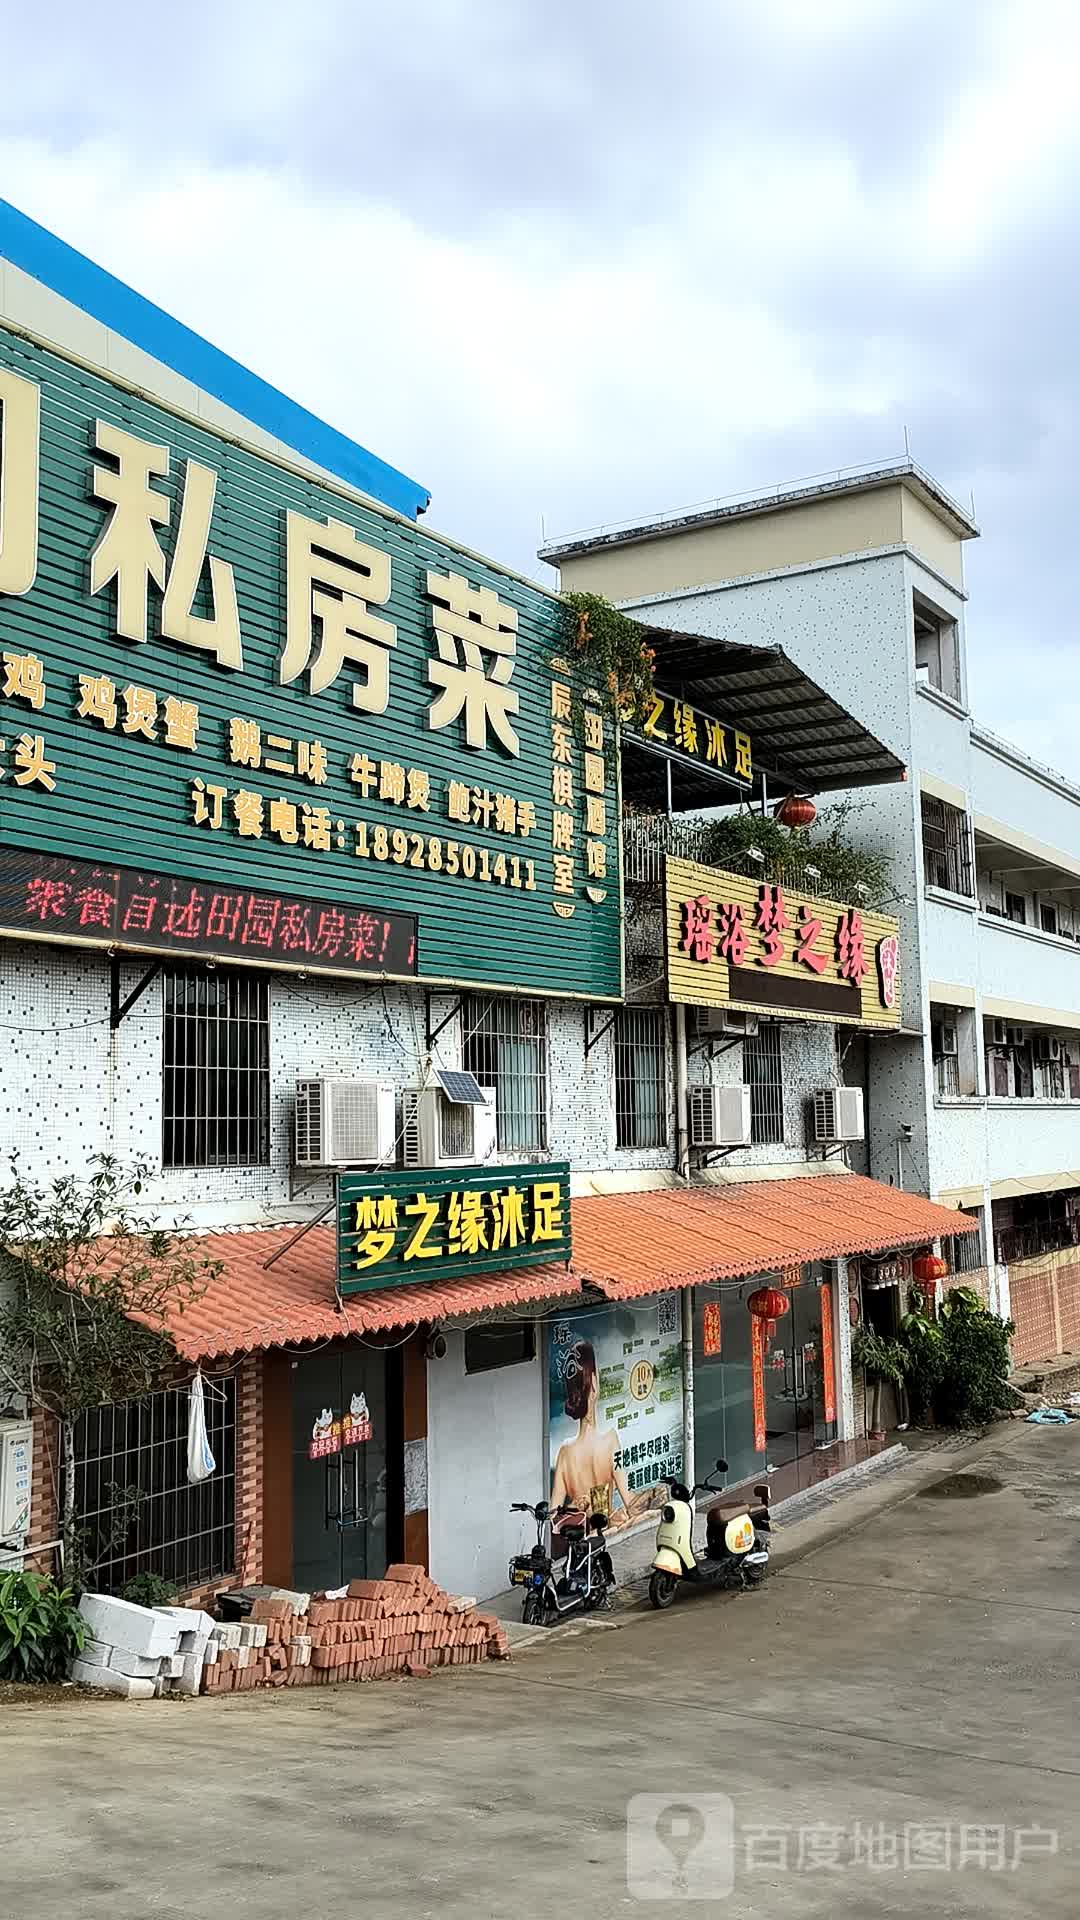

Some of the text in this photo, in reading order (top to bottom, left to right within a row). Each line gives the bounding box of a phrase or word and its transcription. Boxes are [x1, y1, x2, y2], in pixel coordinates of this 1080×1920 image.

[0, 368, 519, 757] 私房菜
[0, 733, 56, 792] 头
[77, 674, 200, 751] 鸡煲蟹
[229, 717, 328, 785] 鹅二味
[351, 753, 431, 812] 牛蹄煲
[448, 779, 537, 837] 鲍汁猪手
[551, 680, 575, 894] 辰东棋牌室
[585, 709, 607, 878] 田园酒馆
[620, 688, 753, 783] 之缘沐足
[356, 1182, 563, 1269] 梦之缘沐足
